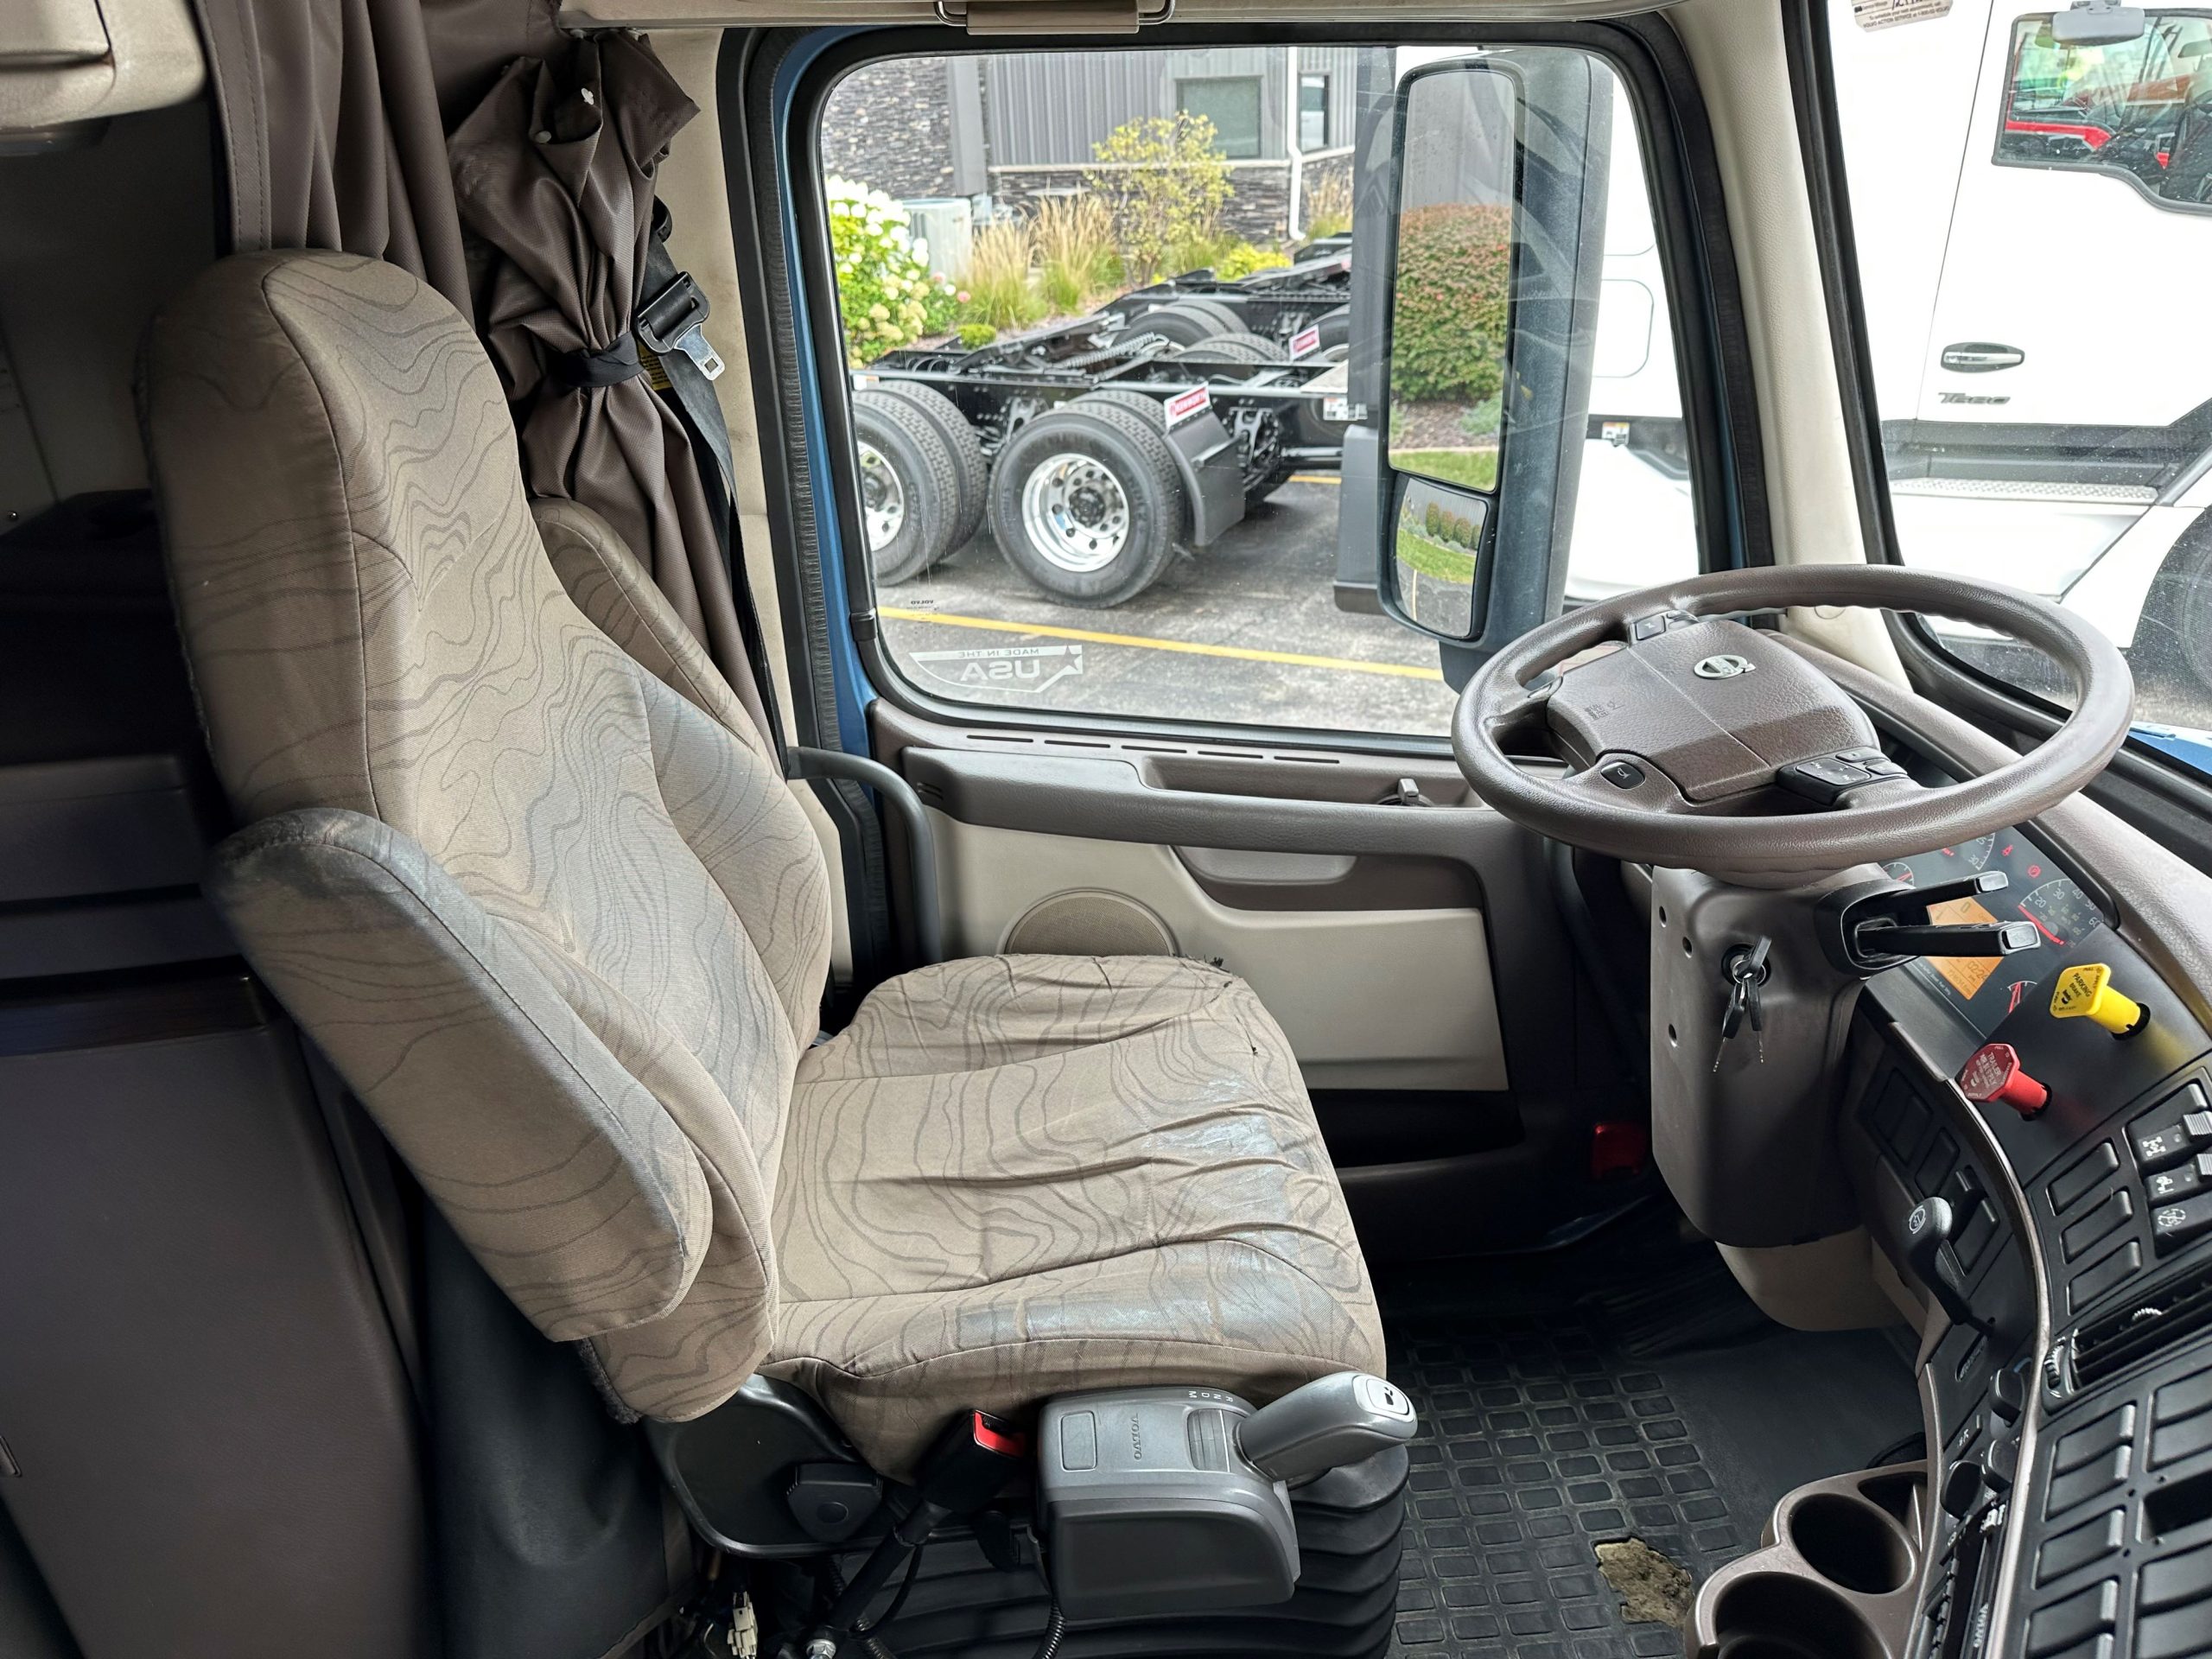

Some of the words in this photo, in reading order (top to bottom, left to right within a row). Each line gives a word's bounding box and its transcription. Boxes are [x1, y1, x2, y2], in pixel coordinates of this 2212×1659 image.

[2051, 887, 2065, 899] 30
[2071, 887, 2084, 899] 40
[2034, 896, 2047, 908] 20
[2069, 982, 2082, 997] BRAKE
[2071, 972, 2092, 997] PARKING
[1986, 1052, 2002, 1077] TRAILER
[1131, 1413, 1142, 1460] VOLVO
